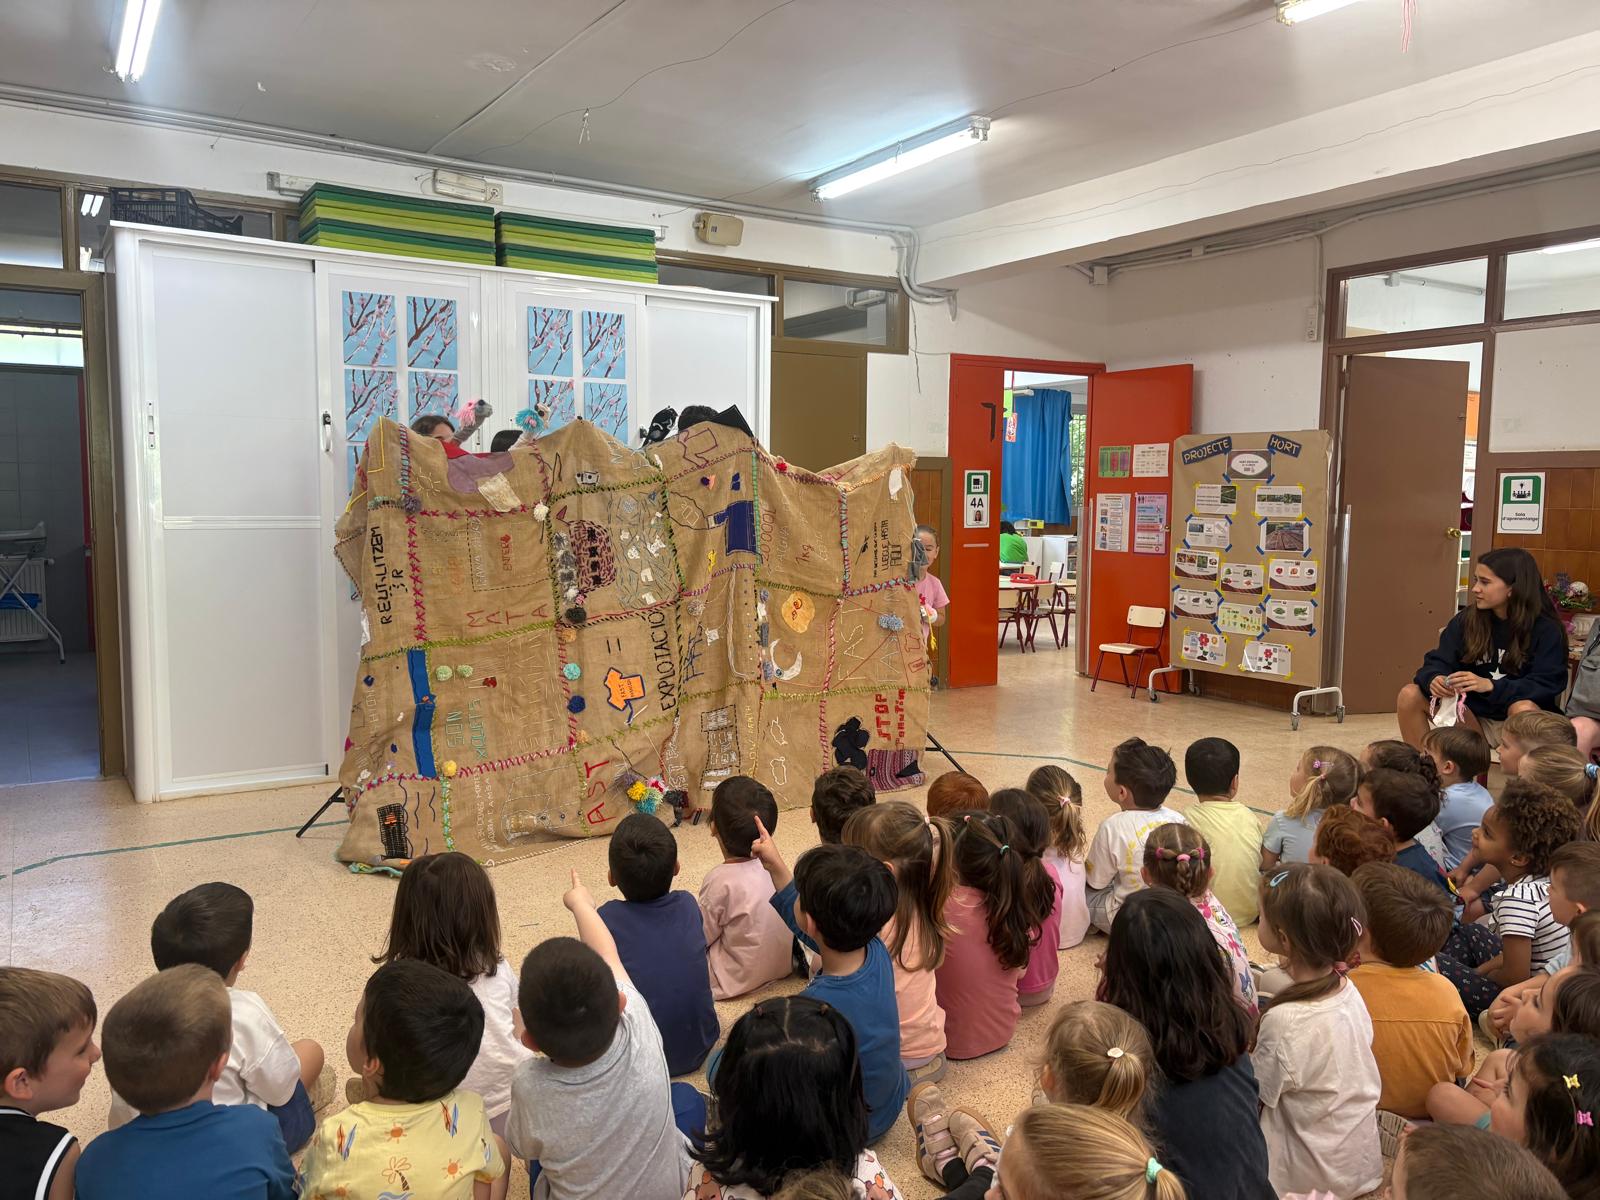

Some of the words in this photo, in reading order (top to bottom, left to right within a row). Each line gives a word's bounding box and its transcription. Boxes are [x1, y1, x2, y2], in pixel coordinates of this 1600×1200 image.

[1183, 439, 1230, 462] PROJECTE
[1271, 437, 1300, 455] HORT
[970, 497, 984, 508] 4A
[874, 694, 892, 741] STOP
